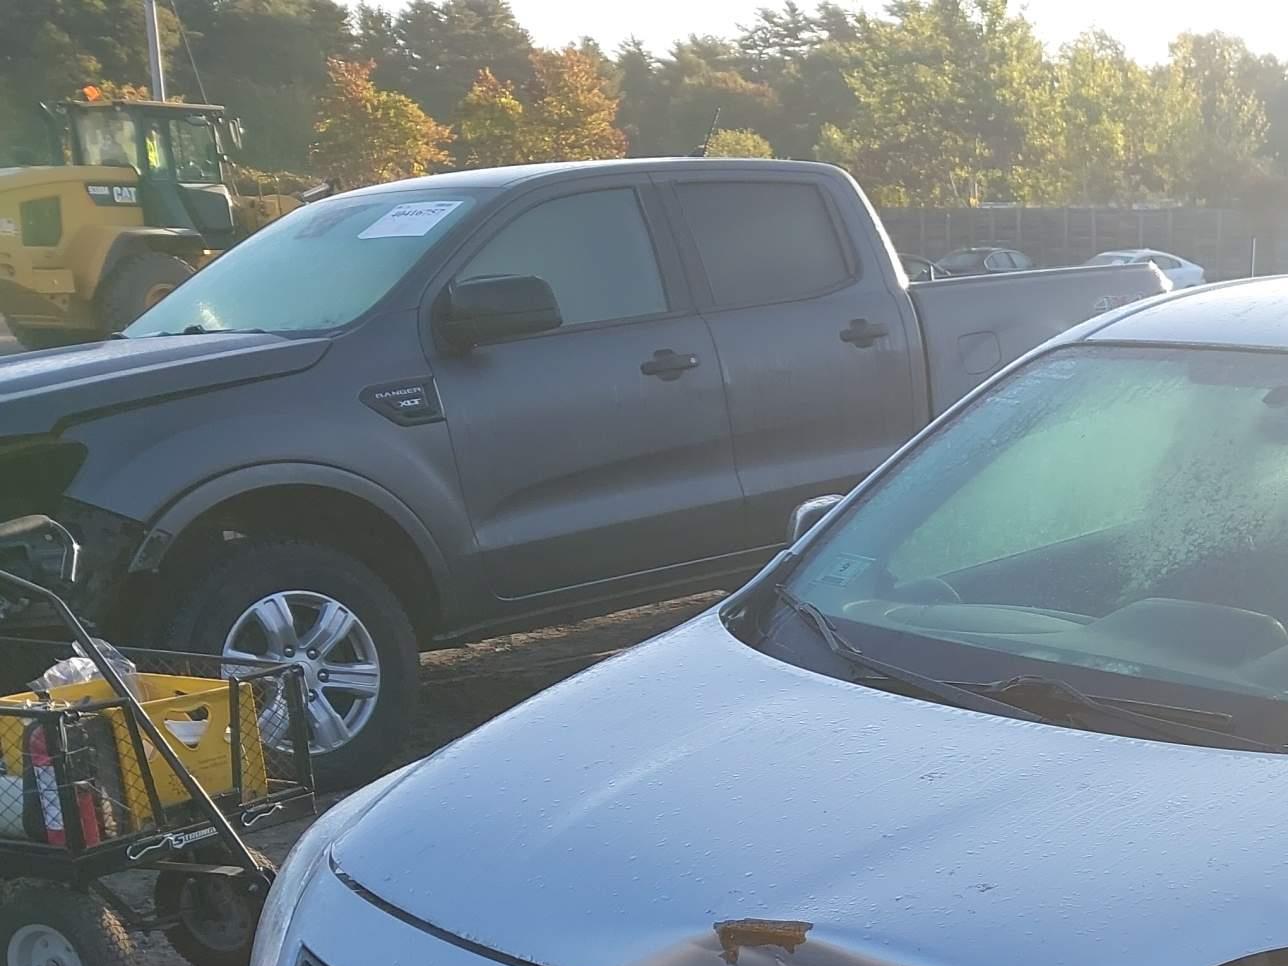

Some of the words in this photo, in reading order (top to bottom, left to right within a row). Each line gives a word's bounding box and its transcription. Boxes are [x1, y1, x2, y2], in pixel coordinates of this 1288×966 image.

[113, 186, 137, 203] CAT
[375, 386, 422, 399] RANGER
[399, 398, 422, 408] XLT
